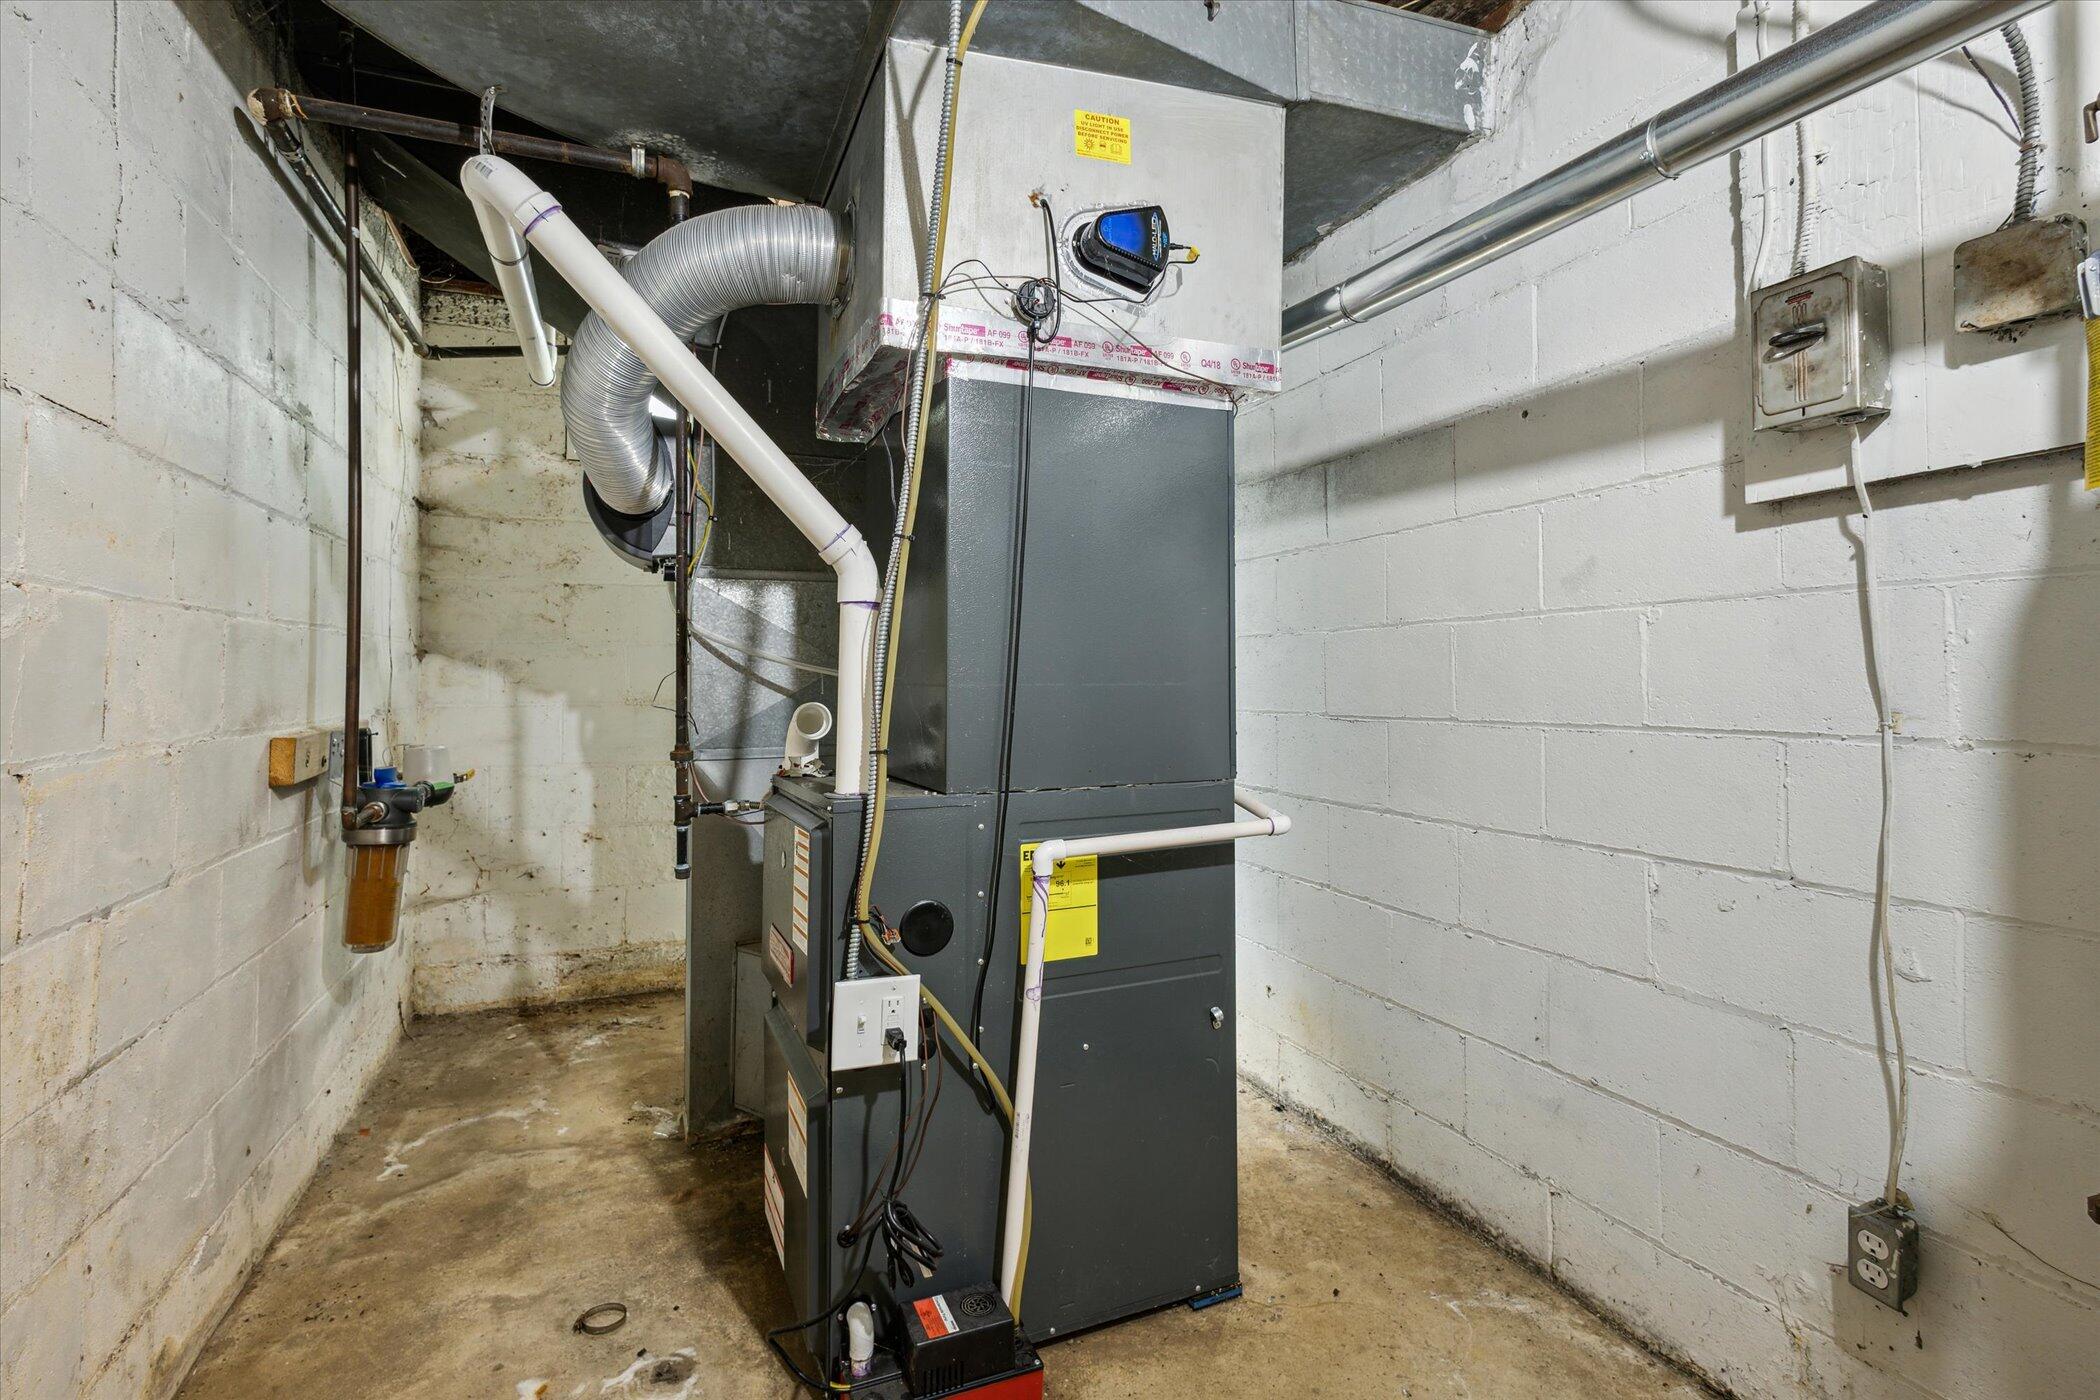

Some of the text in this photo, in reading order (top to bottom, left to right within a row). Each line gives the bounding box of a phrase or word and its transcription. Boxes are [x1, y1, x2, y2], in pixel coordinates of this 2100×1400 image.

[1085, 114, 1119, 125] CAUTION
[1089, 122, 1106, 130] LIGHT
[1076, 125, 1129, 139] DISCONNECT POWER
[1100, 135, 1127, 144] SERVICING
[986, 329, 998, 338] AF
[998, 330, 1012, 340] 099
[1073, 340, 1084, 348] AF
[1083, 342, 1096, 350] 099
[1062, 349, 1089, 358] 181B-FX
[1163, 352, 1175, 360] 099
[1117, 355, 1139, 363] 181A-P
[1200, 358, 1222, 370] Q4/18
[1243, 372, 1262, 380] 181A-P
[1055, 879, 1070, 888] 96.1
